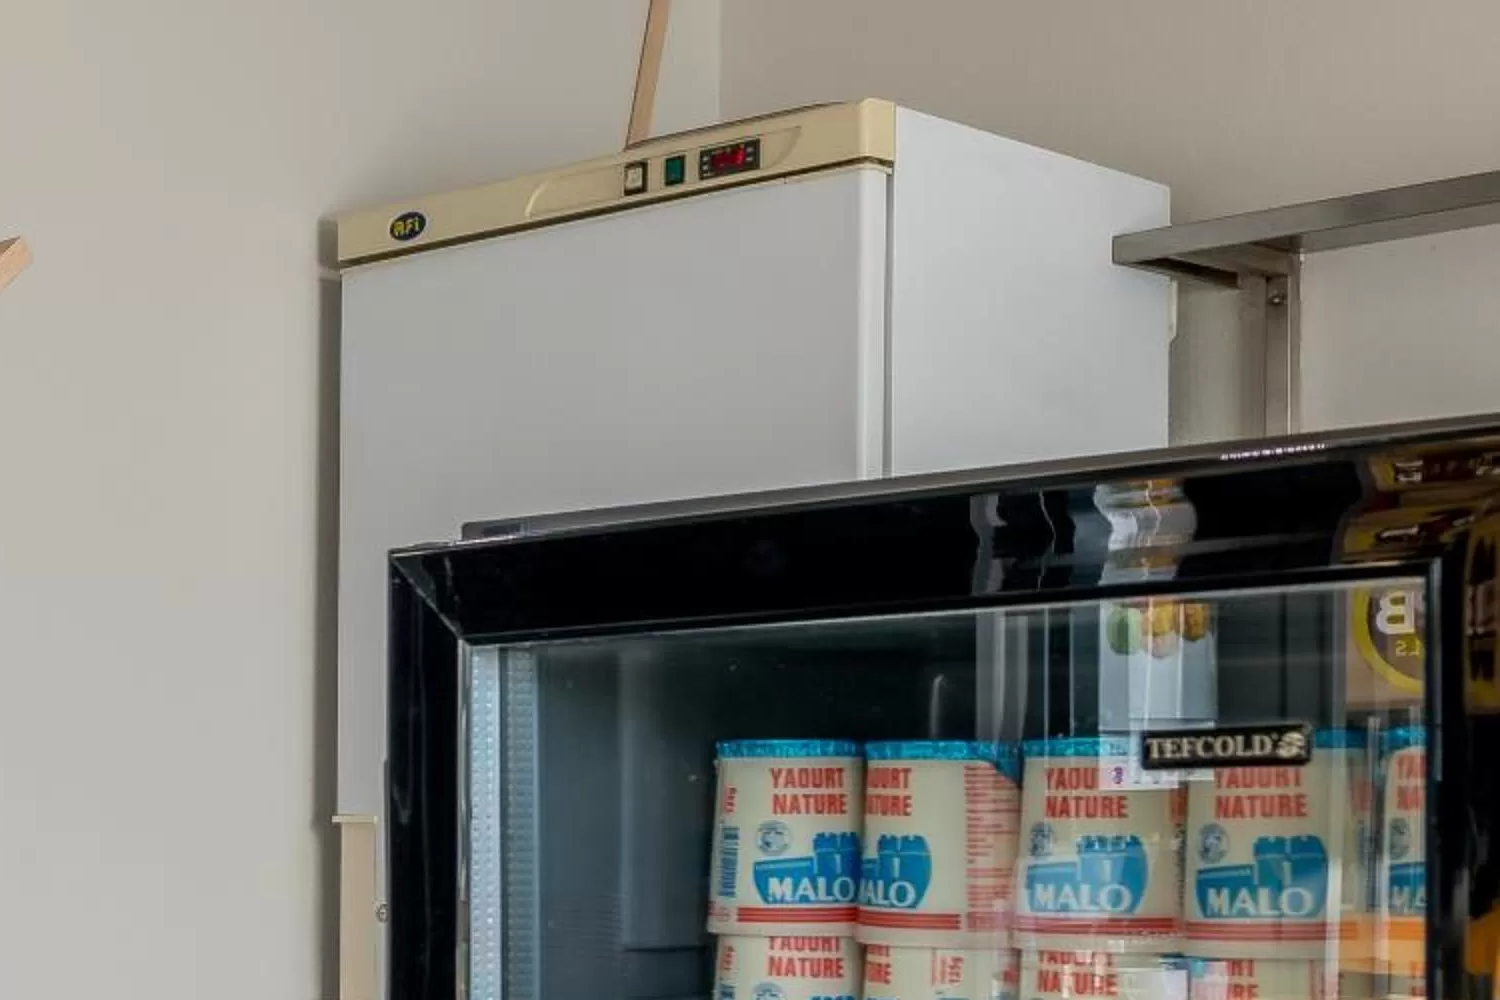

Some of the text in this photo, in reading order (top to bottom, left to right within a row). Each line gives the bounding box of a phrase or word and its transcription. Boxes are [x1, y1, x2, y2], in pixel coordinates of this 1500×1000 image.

[1145, 734, 1273, 759] TEFCOLD
[770, 768, 844, 788] YAOURT
[1046, 767, 1100, 790] YAOU
[771, 794, 848, 815] NATURE
[1045, 796, 1128, 818] NATURE
[1215, 795, 1308, 818] NATURE
[767, 877, 857, 902] MALO
[1033, 883, 1133, 912] MALO
[1207, 887, 1315, 915] MALO
[767, 957, 845, 978] NATURE
